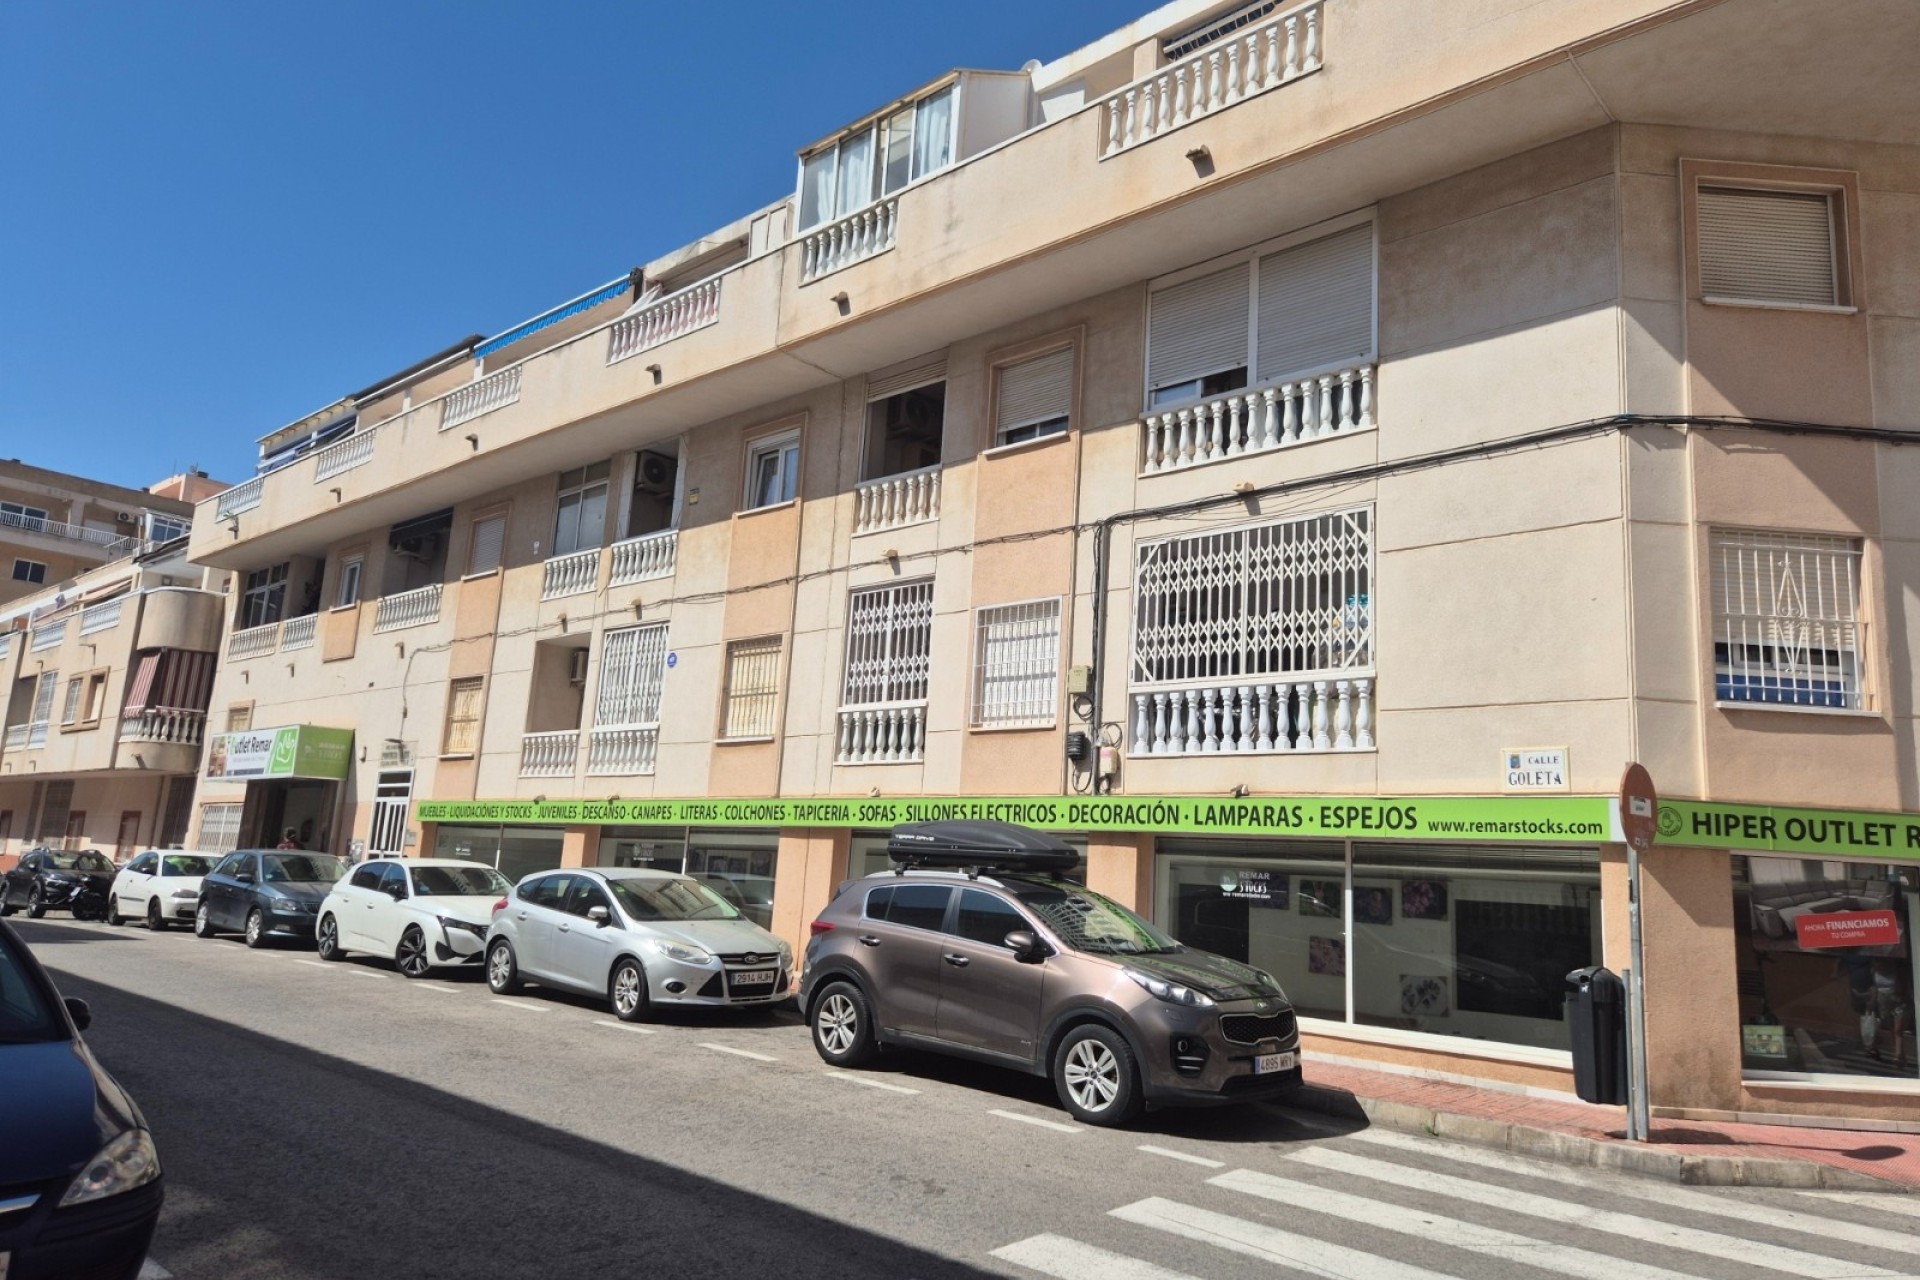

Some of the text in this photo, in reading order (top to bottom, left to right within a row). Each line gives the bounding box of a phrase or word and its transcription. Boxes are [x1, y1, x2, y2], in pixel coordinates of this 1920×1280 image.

[1528, 755, 1560, 765] CALLE
[1508, 770, 1562, 786] GOLETA
[419, 805, 447, 818] MUEBLES
[500, 805, 506, 818] Y
[505, 805, 532, 819] STOCKS
[537, 805, 578, 819] JUVENILES
[582, 805, 625, 820] DESCANSO
[631, 805, 673, 820] CANAPES
[680, 805, 718, 820] LITERAS
[724, 805, 786, 821] COLCHONES
[793, 805, 849, 821] TAPICERIA
[858, 804, 896, 822] SOFAS
[905, 804, 967, 822] SILLONES
[971, 803, 1057, 823] ELECTRICOS
[1068, 800, 1179, 826] DECORACIÓN
[1193, 804, 1303, 828] LAMPARAS
[1320, 805, 1418, 831] ESPEJOS
[1428, 818, 1603, 835] www.remarstocks.com
[1692, 812, 1777, 840] HIPER
[1785, 817, 1896, 847] OUTLET
[1239, 870, 1270, 880] REMAR
[1825, 918, 1889, 931] FINANCIAMOS
